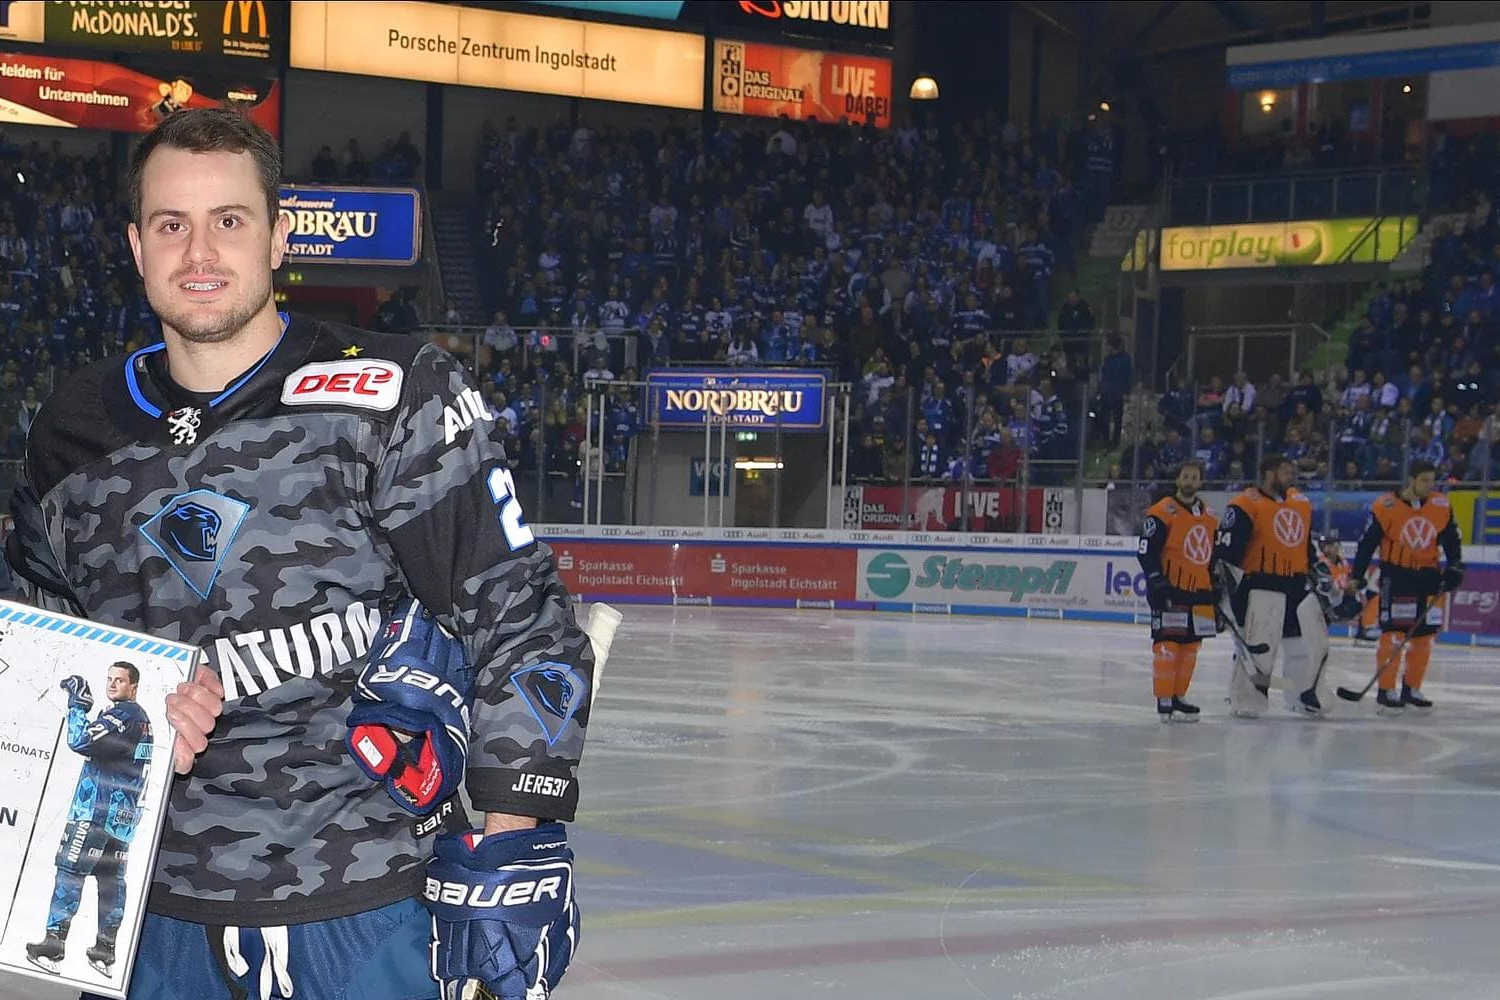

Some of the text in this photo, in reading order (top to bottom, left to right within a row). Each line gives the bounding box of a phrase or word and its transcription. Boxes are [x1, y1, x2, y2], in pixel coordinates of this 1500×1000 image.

[783, 0, 890, 29] SATURN
[388, 28, 617, 73] Porsche Zentrum Ingolstadt
[44, 66, 66, 81] für
[744, 71, 770, 85] DAS
[831, 64, 877, 97] LIVE
[38, 86, 129, 107] Unternehmen
[744, 85, 802, 102] ORIGINAL
[279, 209, 378, 243] DBRÄU
[286, 243, 335, 256] LSTADT
[1167, 232, 1279, 264] forplay
[666, 389, 803, 416] NORDBRÄU
[863, 512, 916, 524] ORIGINL
[579, 559, 634, 573] Sparkasse
[731, 563, 787, 575] Sparkasse
[578, 573, 684, 588] Ingolstadt Eichstätt
[731, 576, 838, 591] Ingolstadt Eichstätt
[915, 554, 1078, 603] Stempfl
[192, 601, 382, 702] ATURN
[0, 740, 50, 760] MONATS
[511, 772, 571, 798] JERS3Y
[67, 820, 91, 864] SATURN
[425, 876, 562, 906] BAUER
